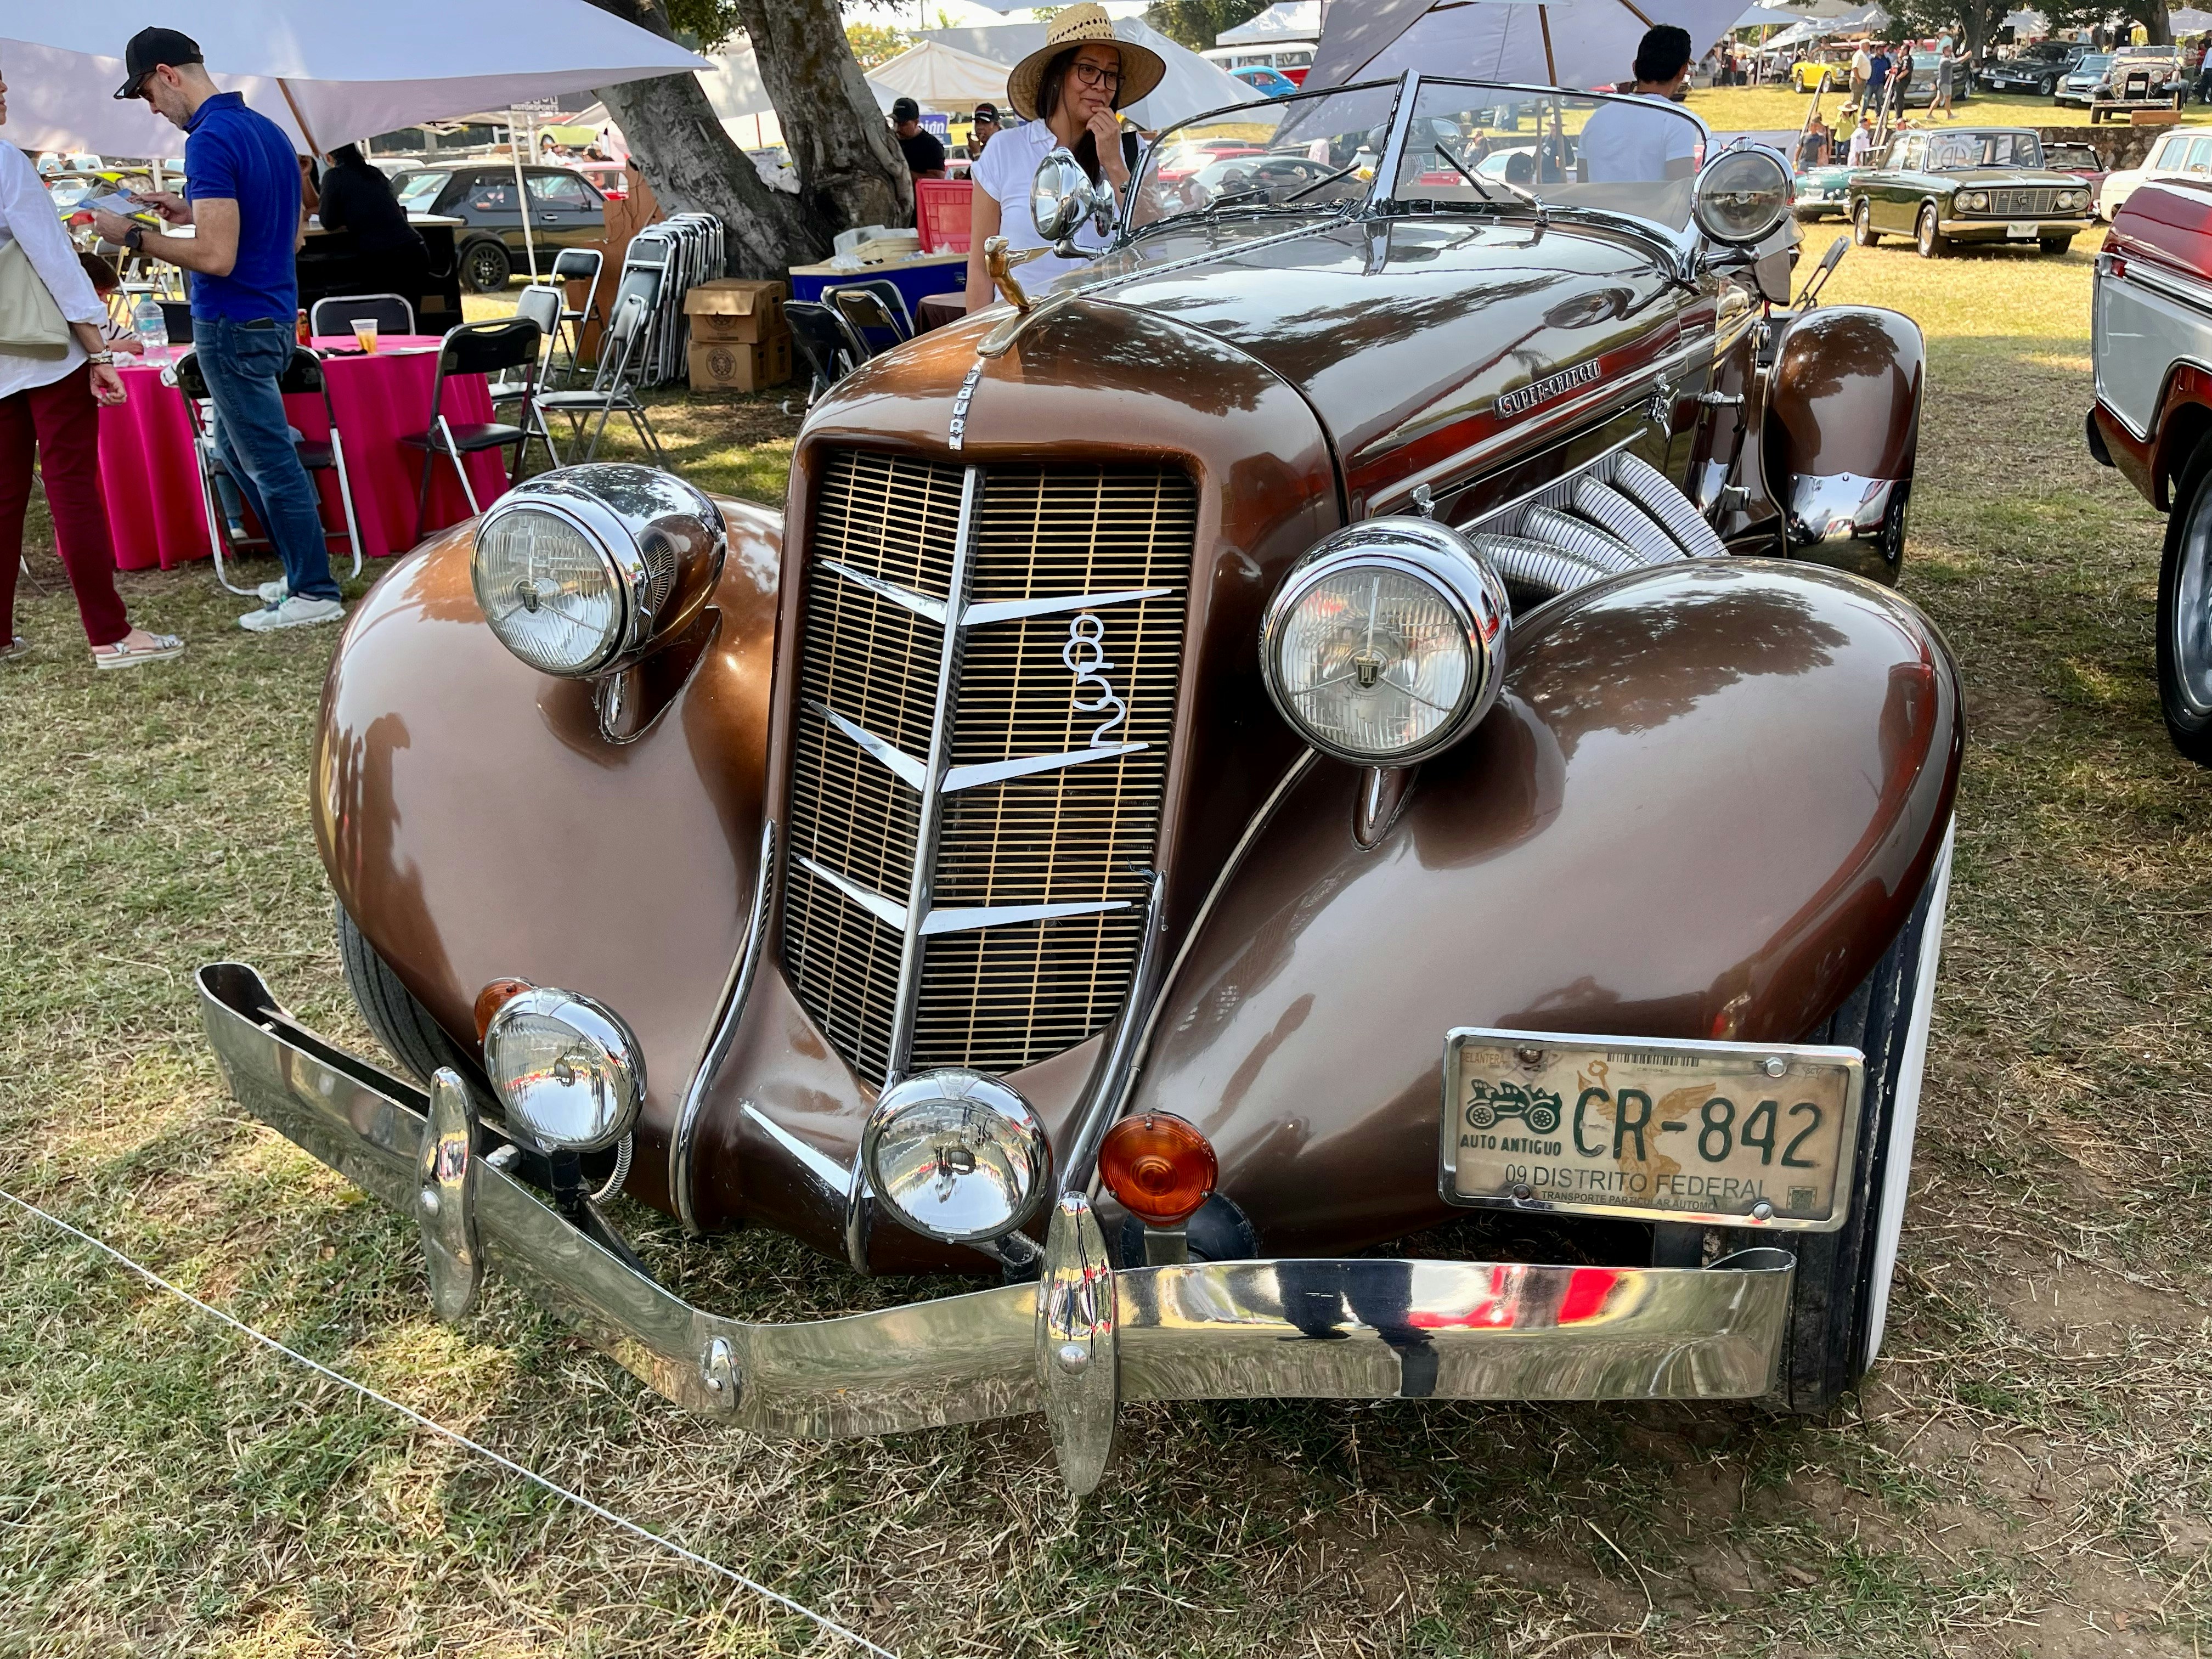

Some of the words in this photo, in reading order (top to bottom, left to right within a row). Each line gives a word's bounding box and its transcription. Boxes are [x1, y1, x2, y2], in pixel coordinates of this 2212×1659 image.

[1503, 360, 1601, 414] SUPER-CHARGED
[1062, 614, 1126, 749] 852
[1460, 1134, 1497, 1150] AUTO
[1500, 1137, 1561, 1156] ANTIGUO
[1572, 1086, 1824, 1168] CR-842
[1505, 1164, 1527, 1183] 09
[1533, 1166, 1647, 1193] DISTRITO
[1655, 1173, 1770, 1200] FEDERAL
[1541, 1190, 1606, 1203] TRANSPORTE
[1607, 1195, 1671, 1207] PARTICULAR
